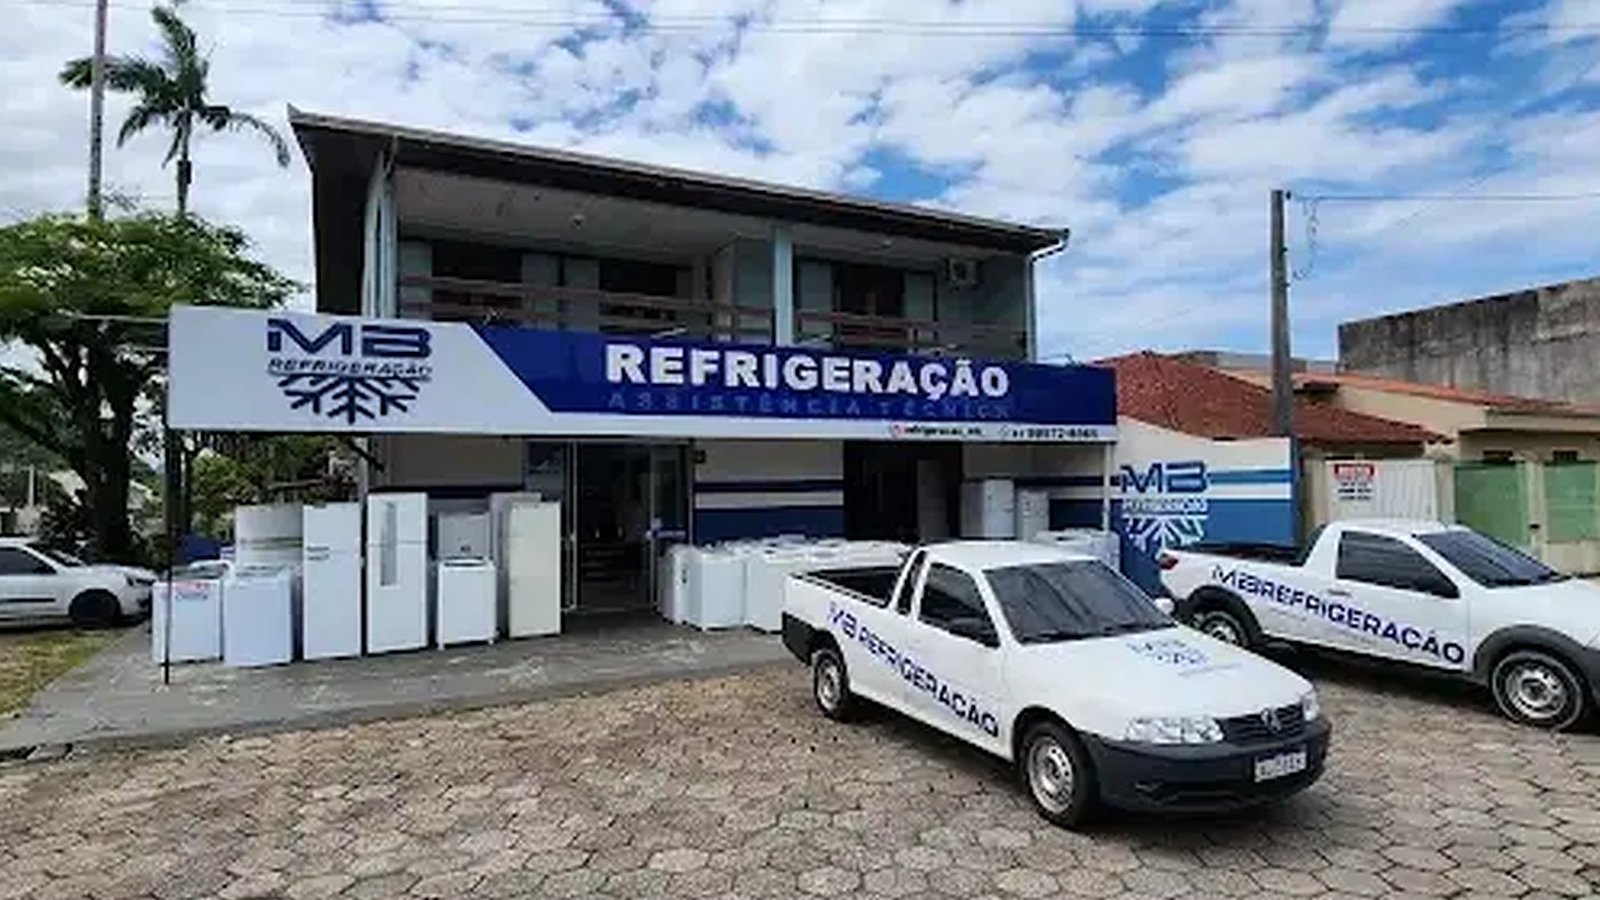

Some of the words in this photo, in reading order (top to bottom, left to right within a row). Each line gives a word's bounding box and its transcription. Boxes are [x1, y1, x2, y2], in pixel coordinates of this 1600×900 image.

[267, 318, 431, 358] MB
[605, 343, 1010, 399] REFRIGERAÇÃO
[1120, 460, 1207, 493] MB
